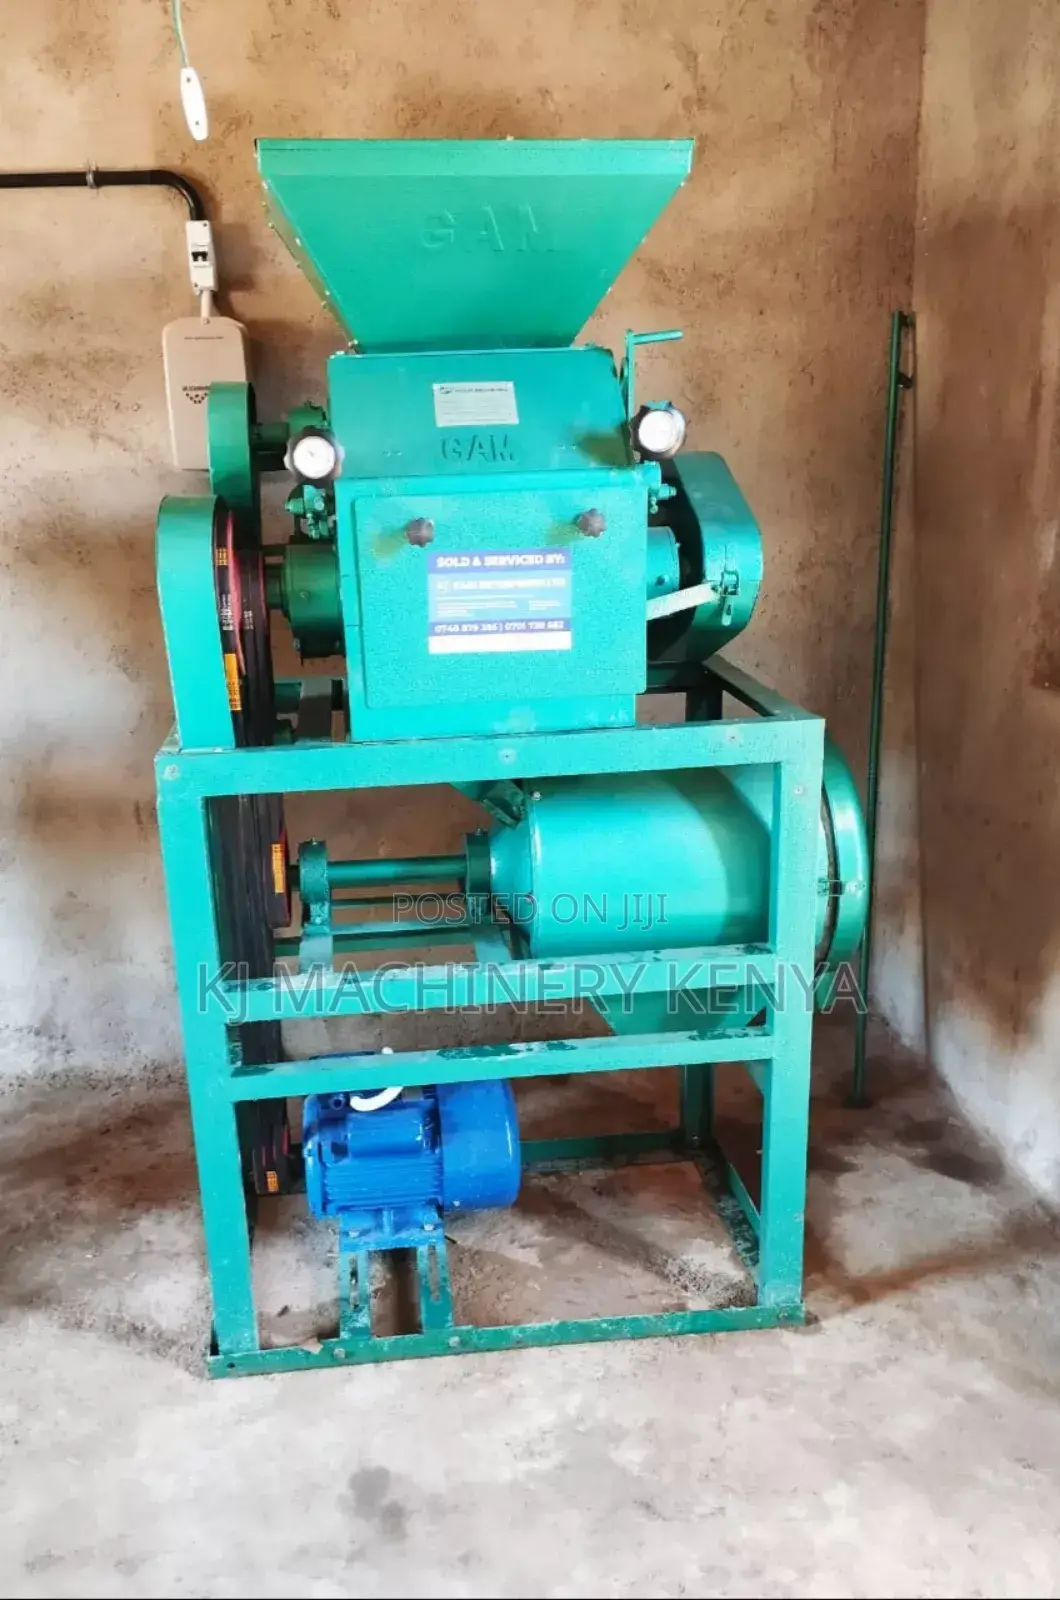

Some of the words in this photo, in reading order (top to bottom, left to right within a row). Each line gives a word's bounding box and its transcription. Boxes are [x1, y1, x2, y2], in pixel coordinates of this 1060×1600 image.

[420, 203, 556, 252] GAM
[440, 434, 516, 462] GAM
[436, 555, 471, 568] SOLD
[483, 553, 544, 567] SERVICED
[545, 552, 566, 565] BY:
